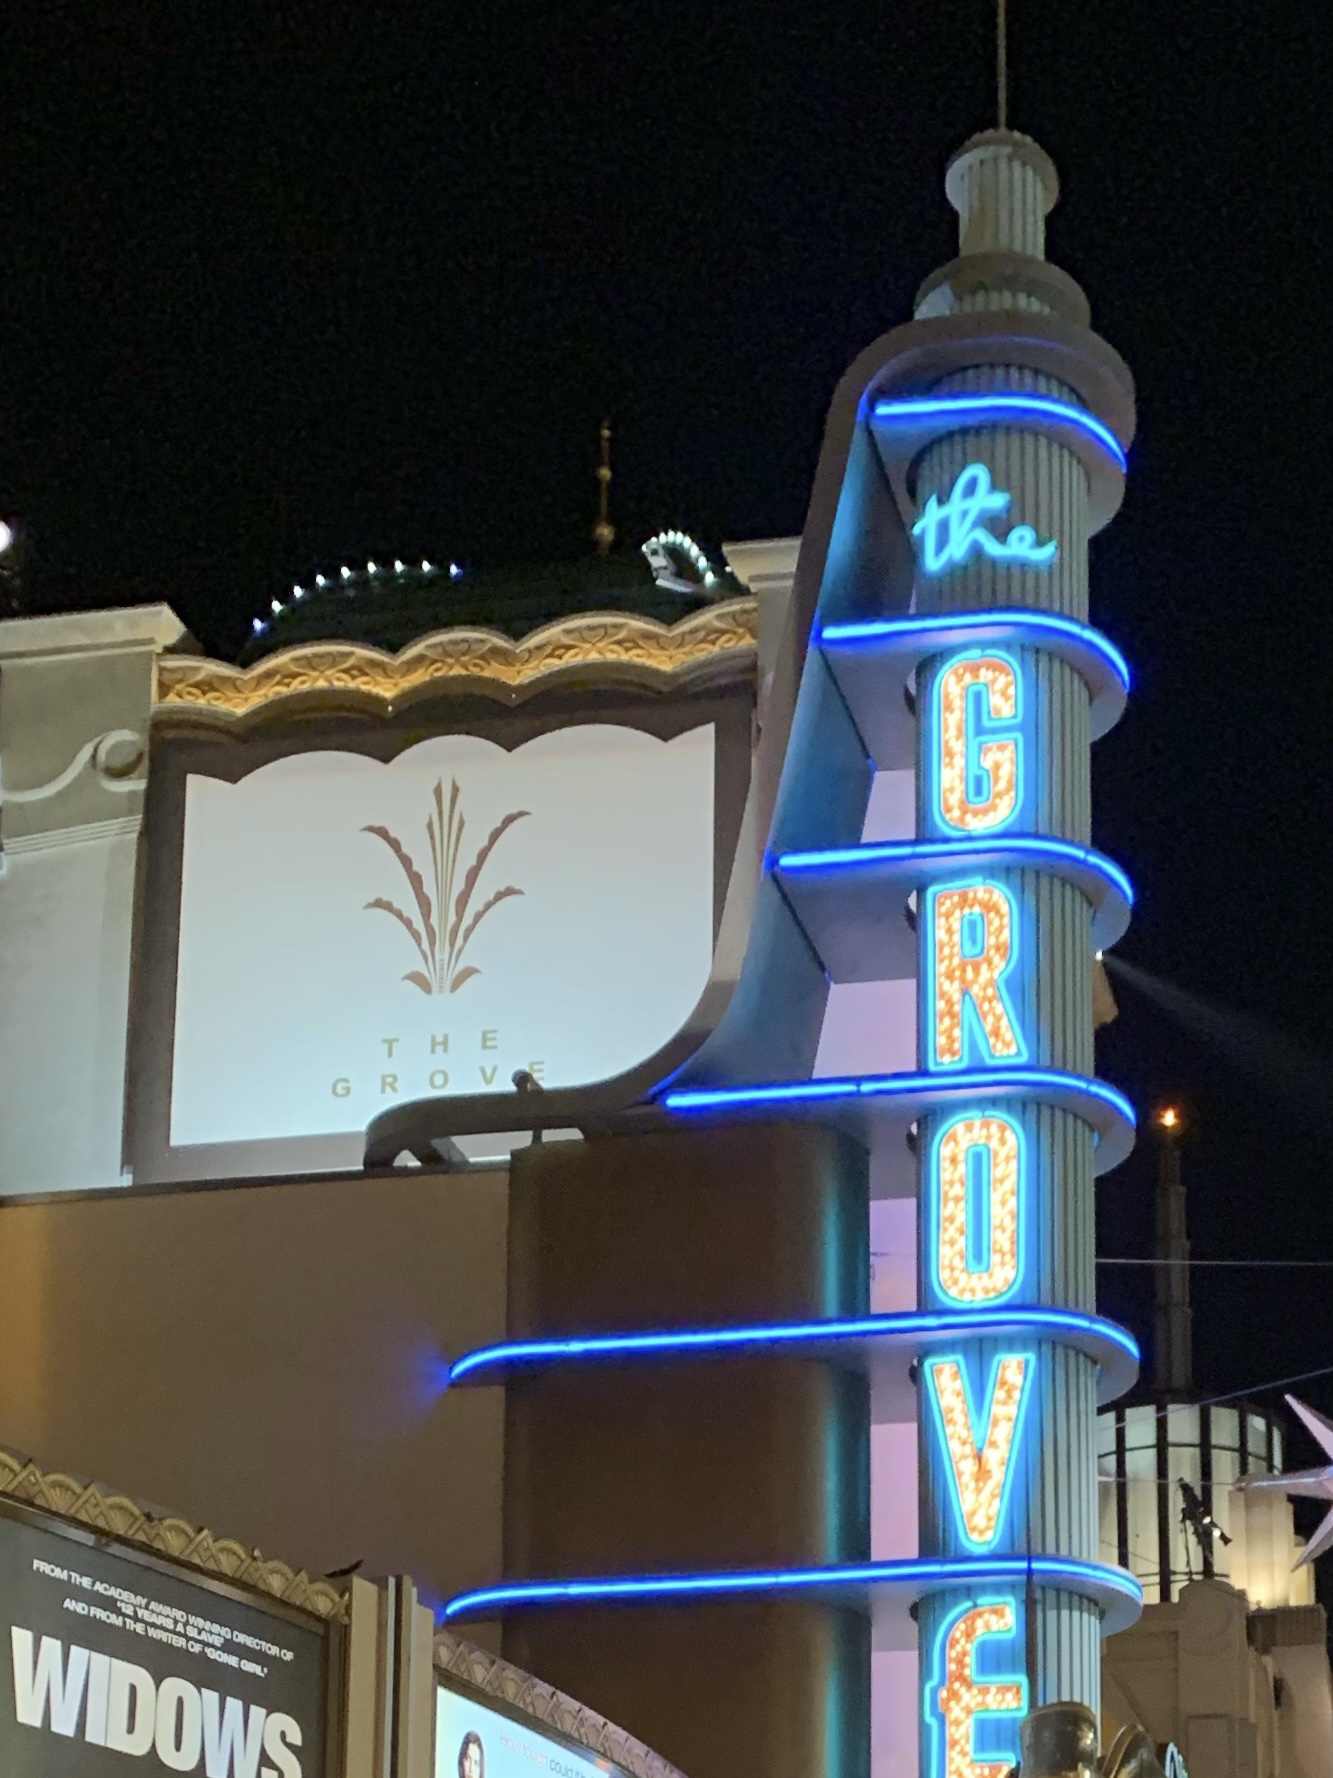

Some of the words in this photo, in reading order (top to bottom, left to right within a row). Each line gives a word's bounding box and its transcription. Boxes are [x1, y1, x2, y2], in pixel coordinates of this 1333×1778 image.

[911, 462, 1058, 575] the
[382, 1029, 498, 1058] THE
[331, 1061, 545, 1098] GROVE
[32, 1558, 68, 1581] FROM
[69, 1571, 93, 1590] THE
[93, 1581, 148, 1608] ACADEMY
[62, 1597, 89, 1616] AND
[89, 1605, 123, 1628] FROM
[123, 1617, 147, 1636] THE
[187, 1640, 204, 1655] OF
[175, 1622, 185, 1634] A
